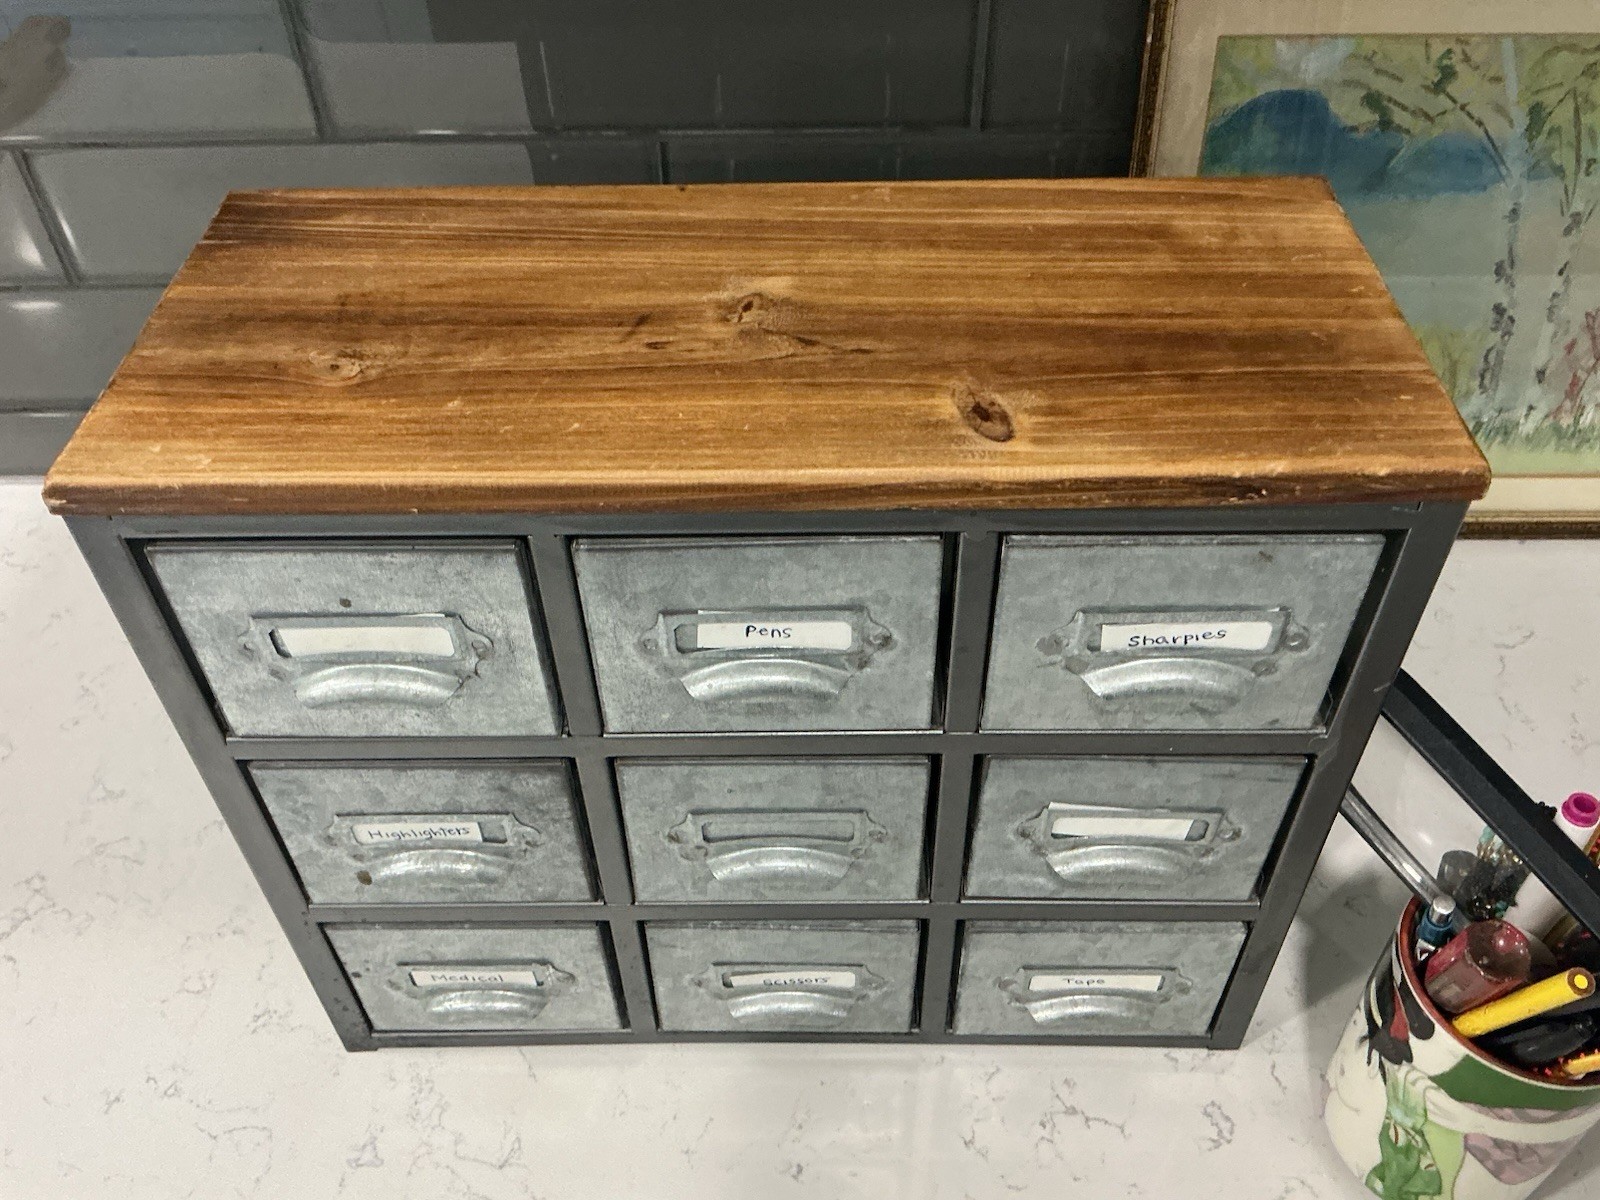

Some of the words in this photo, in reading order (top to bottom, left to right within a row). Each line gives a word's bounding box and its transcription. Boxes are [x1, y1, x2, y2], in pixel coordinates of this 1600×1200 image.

[745, 625, 793, 639] Pens
[368, 826, 471, 841] Highlighters
[431, 973, 504, 983] Medical
[1062, 977, 1106, 986] Tape
